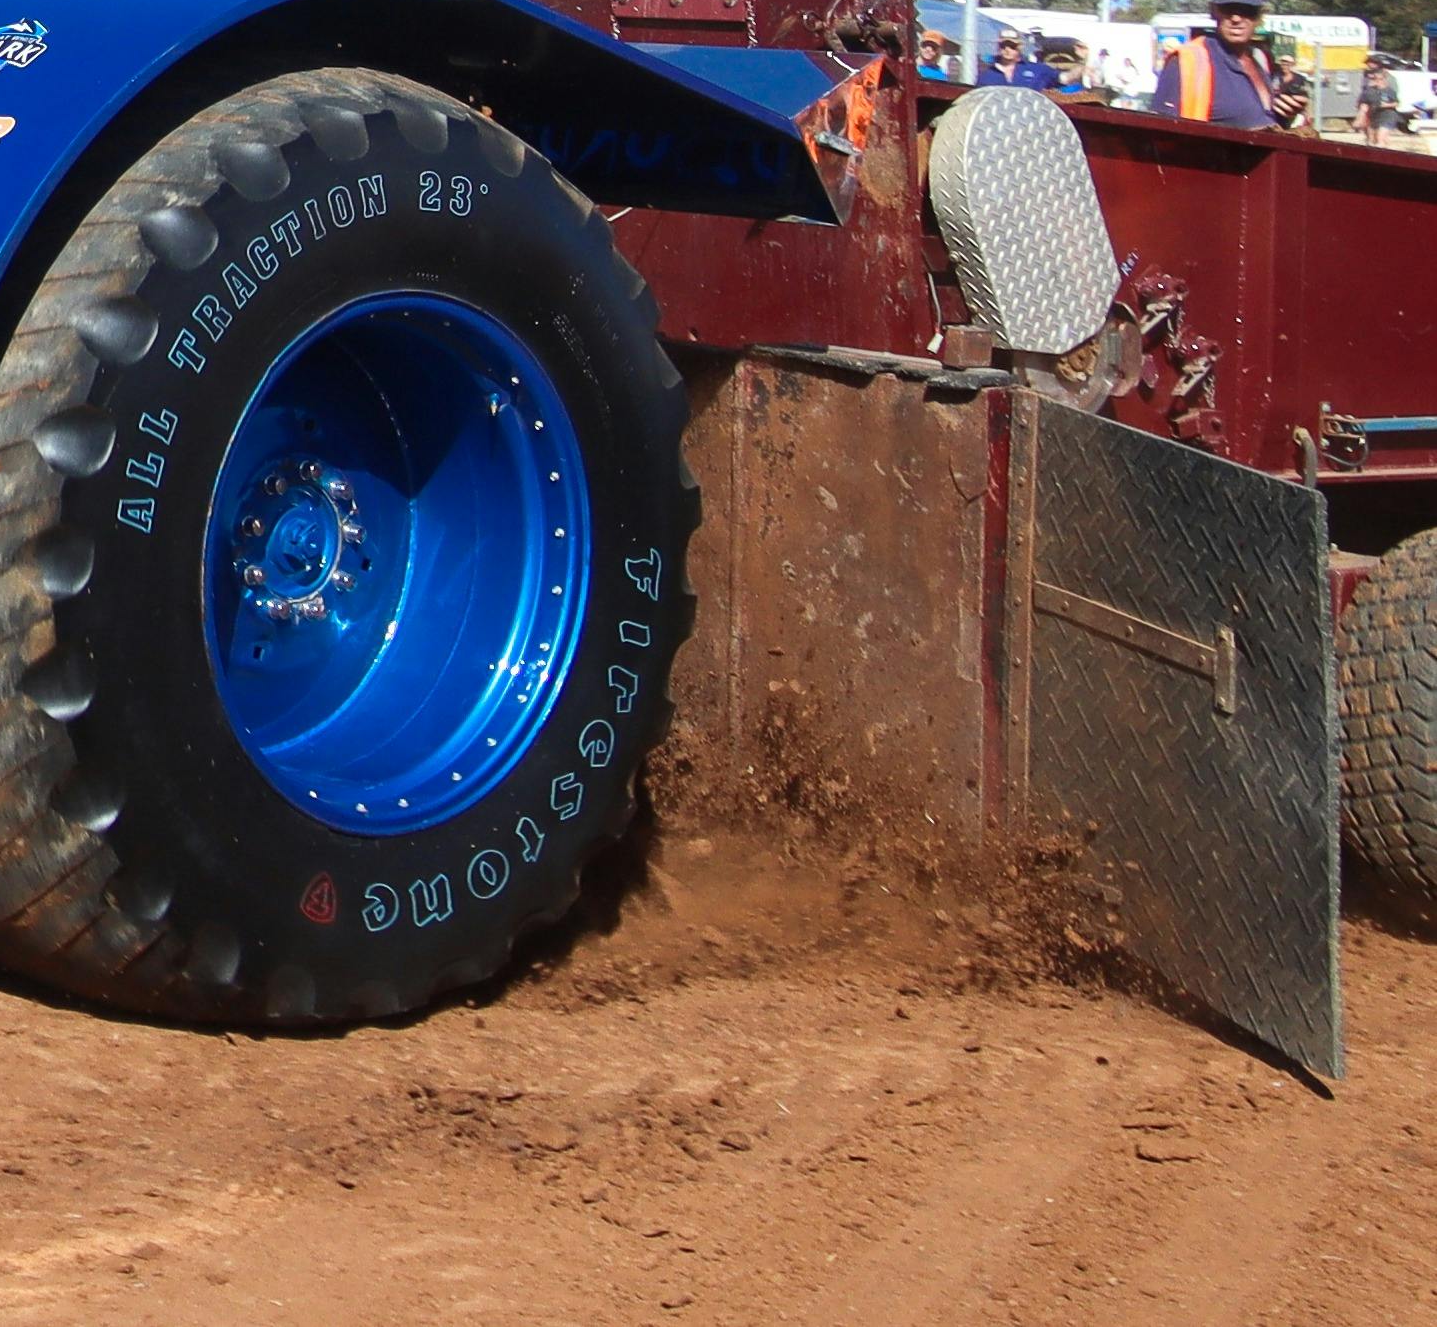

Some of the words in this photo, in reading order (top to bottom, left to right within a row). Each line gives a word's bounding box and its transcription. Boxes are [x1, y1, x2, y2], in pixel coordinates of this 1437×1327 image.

[116, 408, 179, 535] ALL
[167, 174, 389, 375] TRACTION
[362, 547, 662, 933] Firestone
